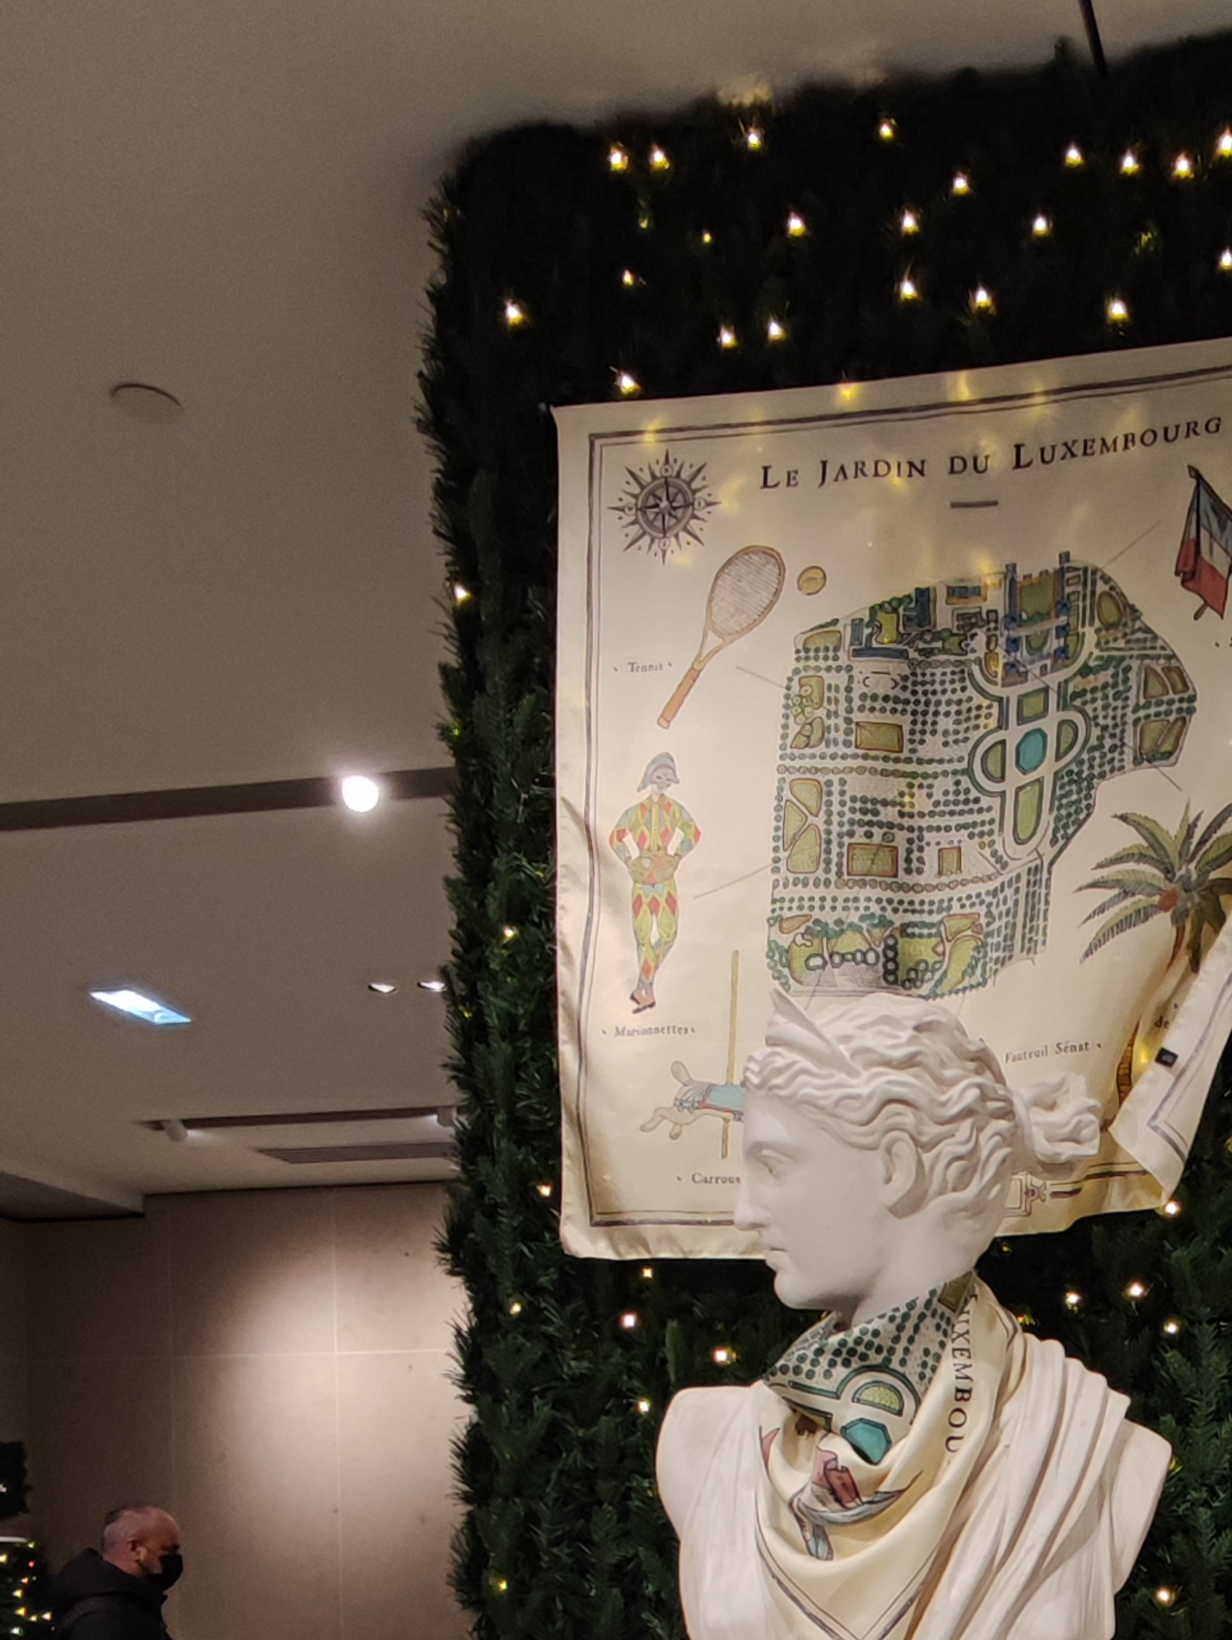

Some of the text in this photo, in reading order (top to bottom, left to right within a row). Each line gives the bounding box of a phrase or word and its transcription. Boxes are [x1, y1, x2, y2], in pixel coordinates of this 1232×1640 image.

[760, 416, 1222, 490] LE JARDIN DU LUXEMBOURG
[1055, 1040, 1090, 1055] Sénat
